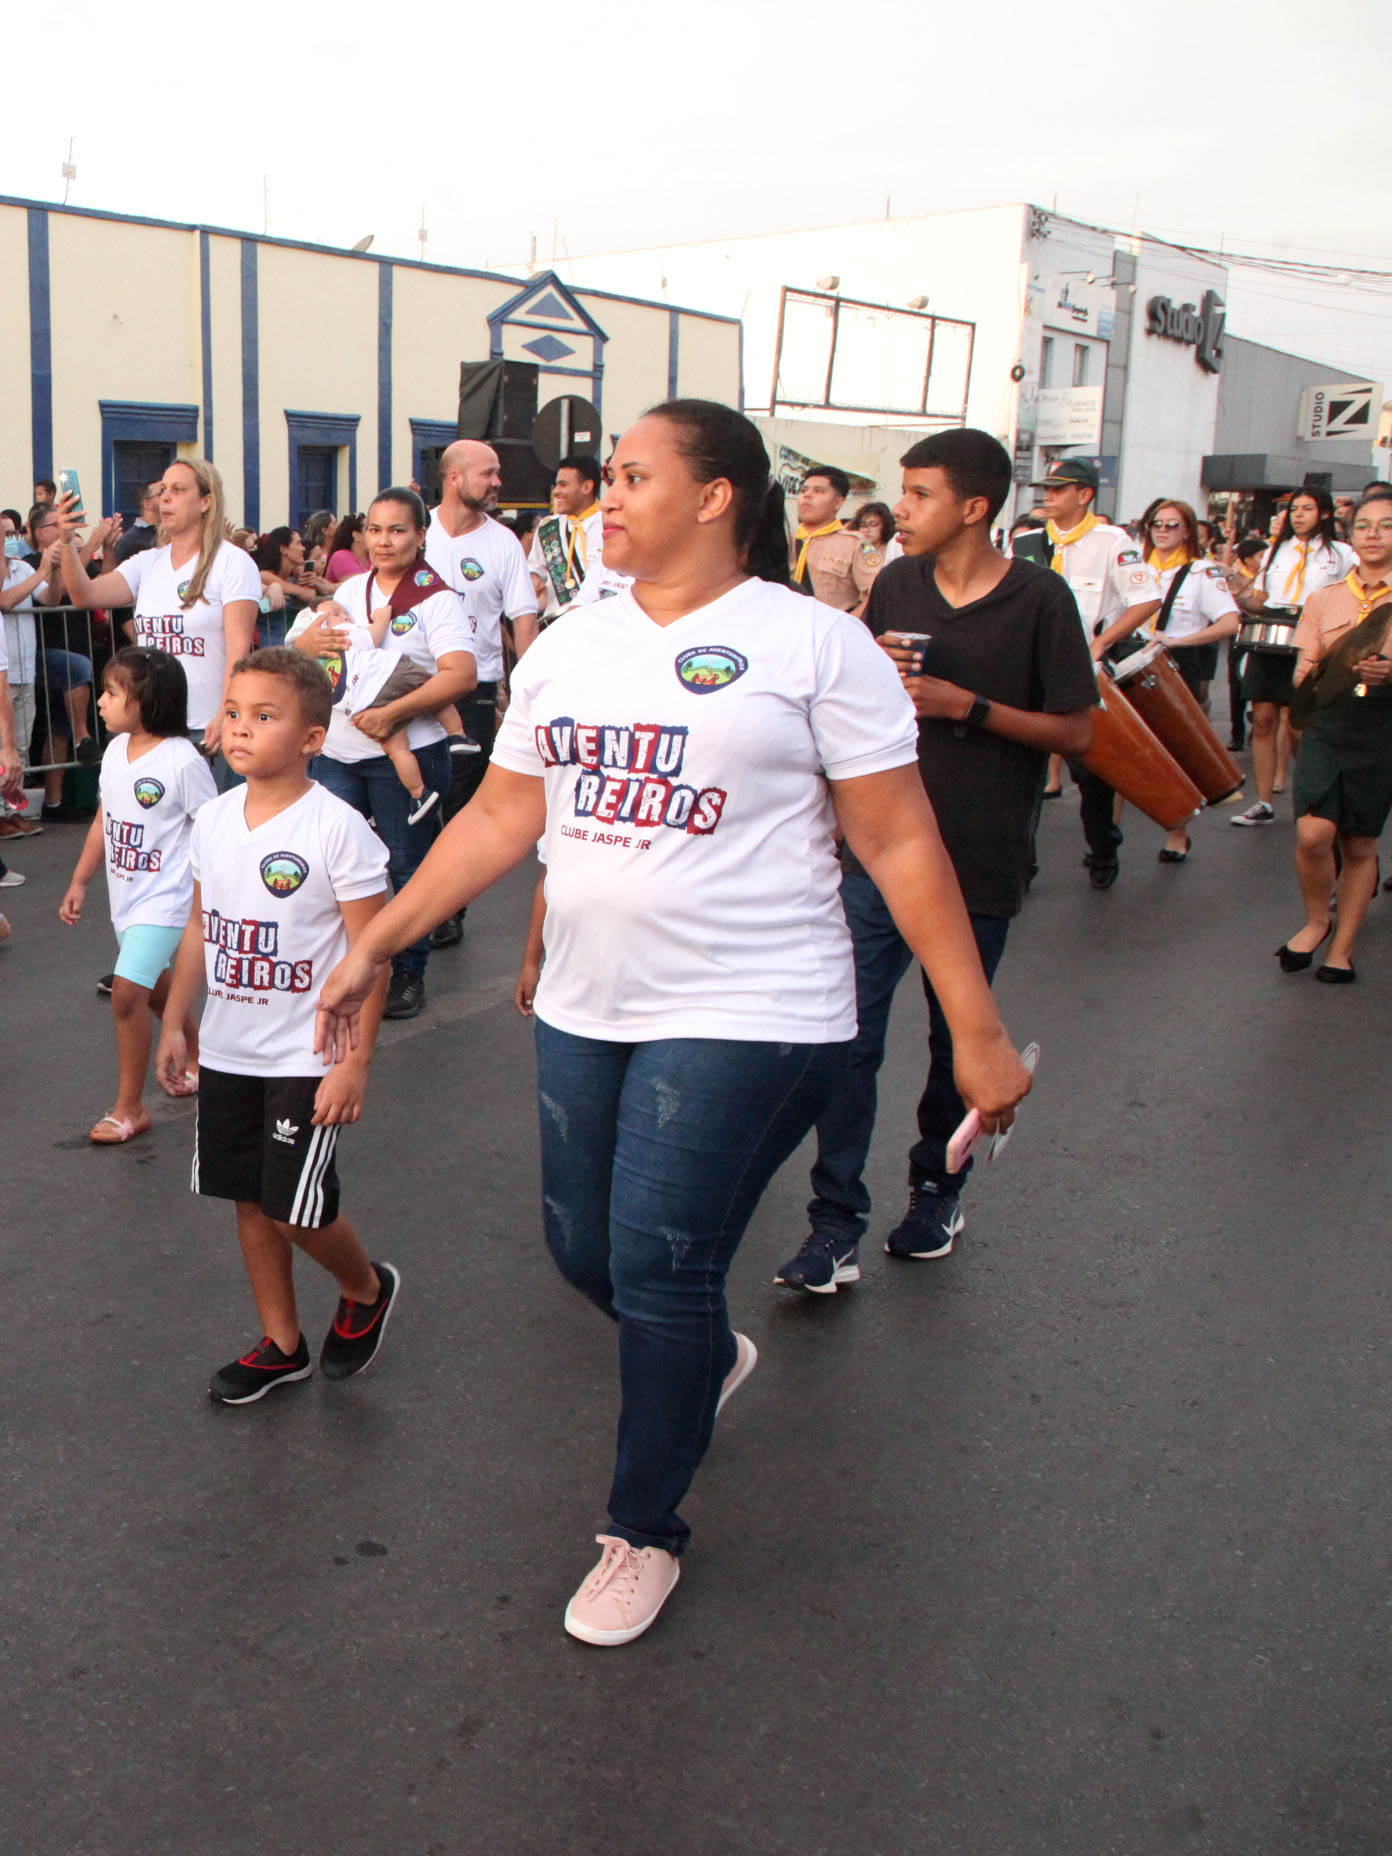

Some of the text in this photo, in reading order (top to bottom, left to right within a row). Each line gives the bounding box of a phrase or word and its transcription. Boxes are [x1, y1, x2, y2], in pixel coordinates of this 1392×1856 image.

[1147, 296, 1204, 345] Studio
[1311, 391, 1325, 437] STUDIO
[678, 650, 697, 663] CLUBE
[535, 717, 689, 778] AVENTU
[574, 769, 728, 835] REIROS
[561, 824, 651, 850] CLUBE JASPE JR
[215, 948, 312, 993] REIROS
[225, 993, 254, 1004] JASPE
[257, 997, 269, 1005] JR
[272, 1132, 295, 1145] adidas
